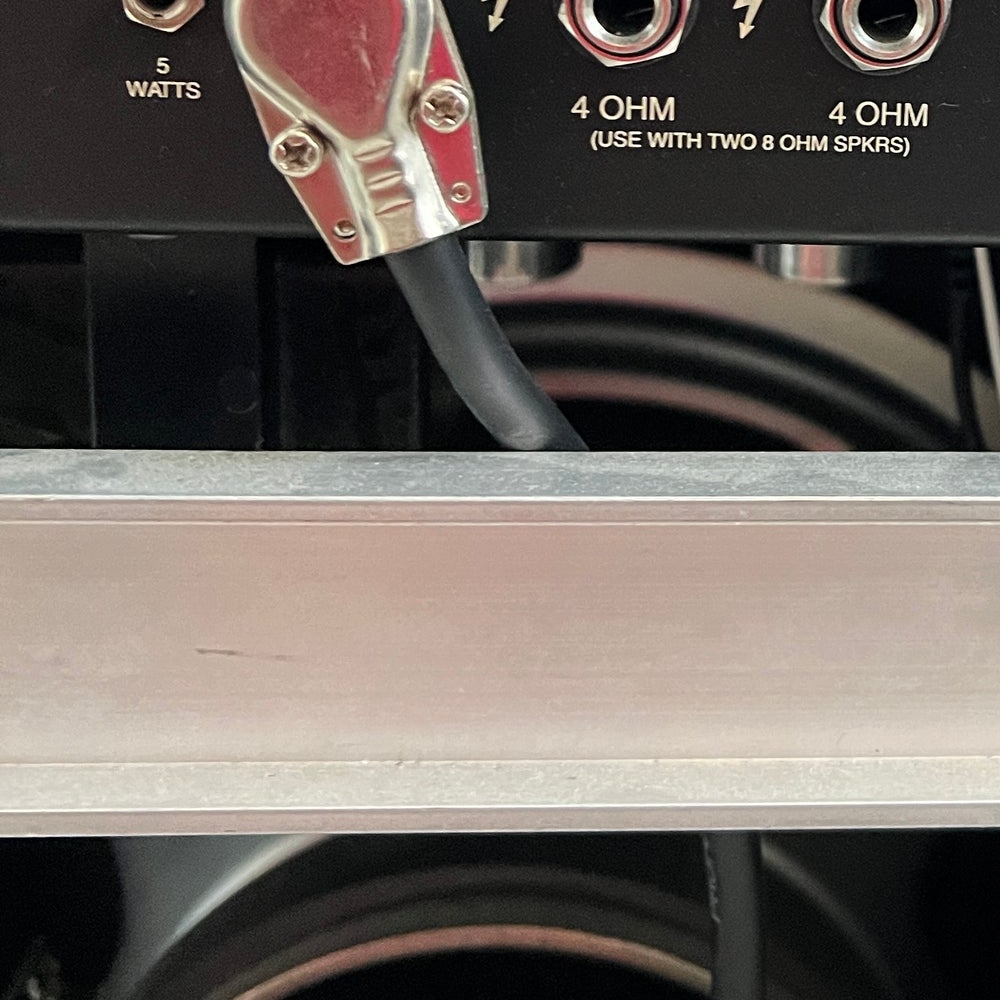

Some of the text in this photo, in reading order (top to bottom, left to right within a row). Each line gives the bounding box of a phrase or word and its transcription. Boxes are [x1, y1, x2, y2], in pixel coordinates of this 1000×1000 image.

[156, 57, 170, 75] 5
[125, 80, 202, 100] WATTS
[570, 94, 675, 122] 4 OHM
[828, 100, 929, 127] 4 OHM
[590, 130, 911, 158] (USE WITH TWO 8 OHM SPKRS)
